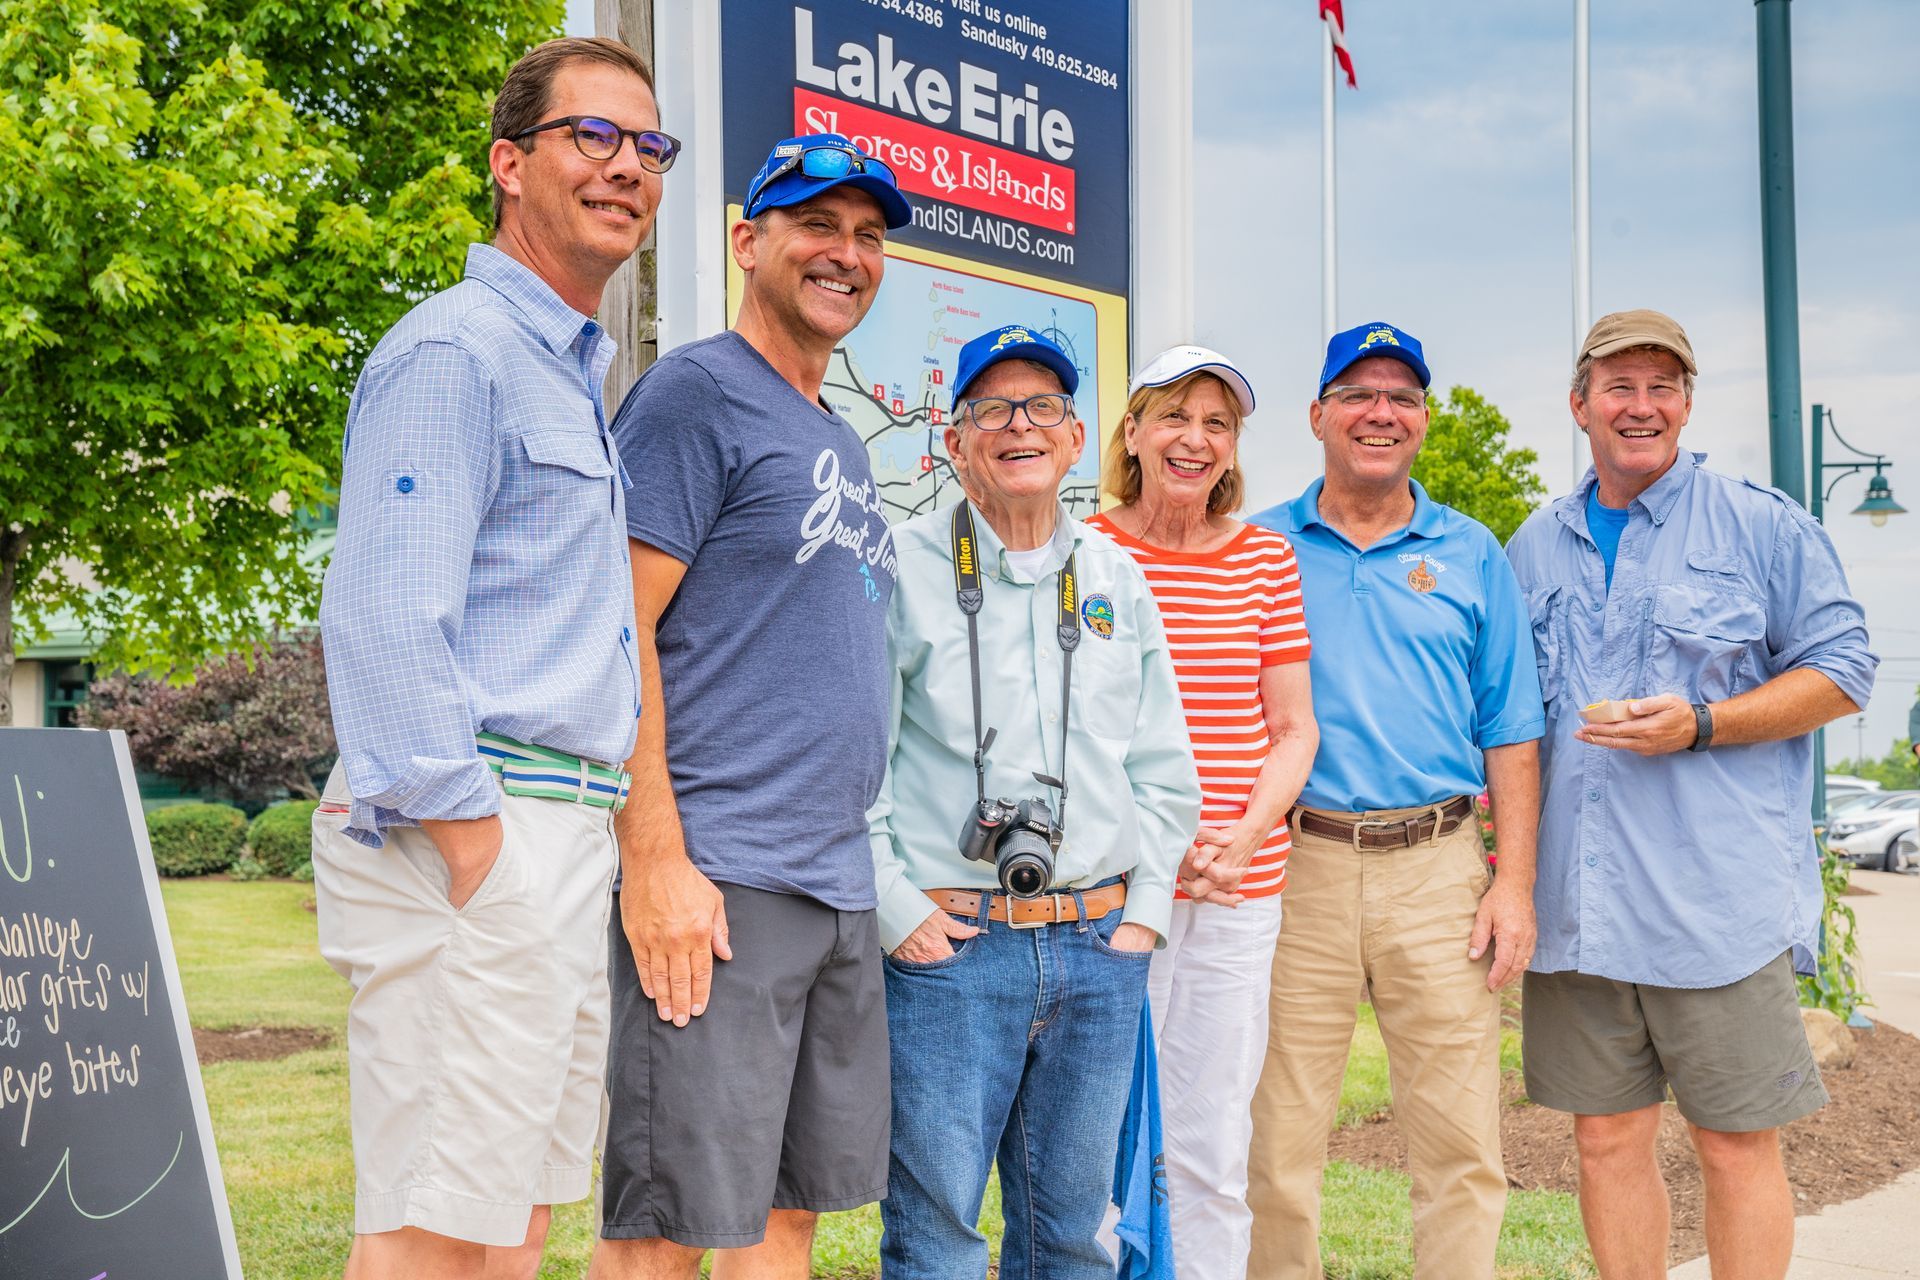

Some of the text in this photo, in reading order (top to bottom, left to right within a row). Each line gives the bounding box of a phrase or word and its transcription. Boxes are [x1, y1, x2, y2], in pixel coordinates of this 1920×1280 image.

[984, 6, 1001, 24] us
[1005, 15, 1047, 41] online
[794, 6, 1075, 161] Lake Erie
[960, 19, 1118, 91] Sandusky 419.625.2984
[930, 146, 960, 194] &
[959, 150, 1066, 212] Islands
[908, 205, 1074, 265] ndISLANDS.com
[959, 537, 974, 575] Nikon
[1063, 573, 1075, 613] Nikon
[1028, 820, 1048, 832] Nikon
[41, 963, 111, 1034] grits
[65, 1041, 140, 1095] bites
